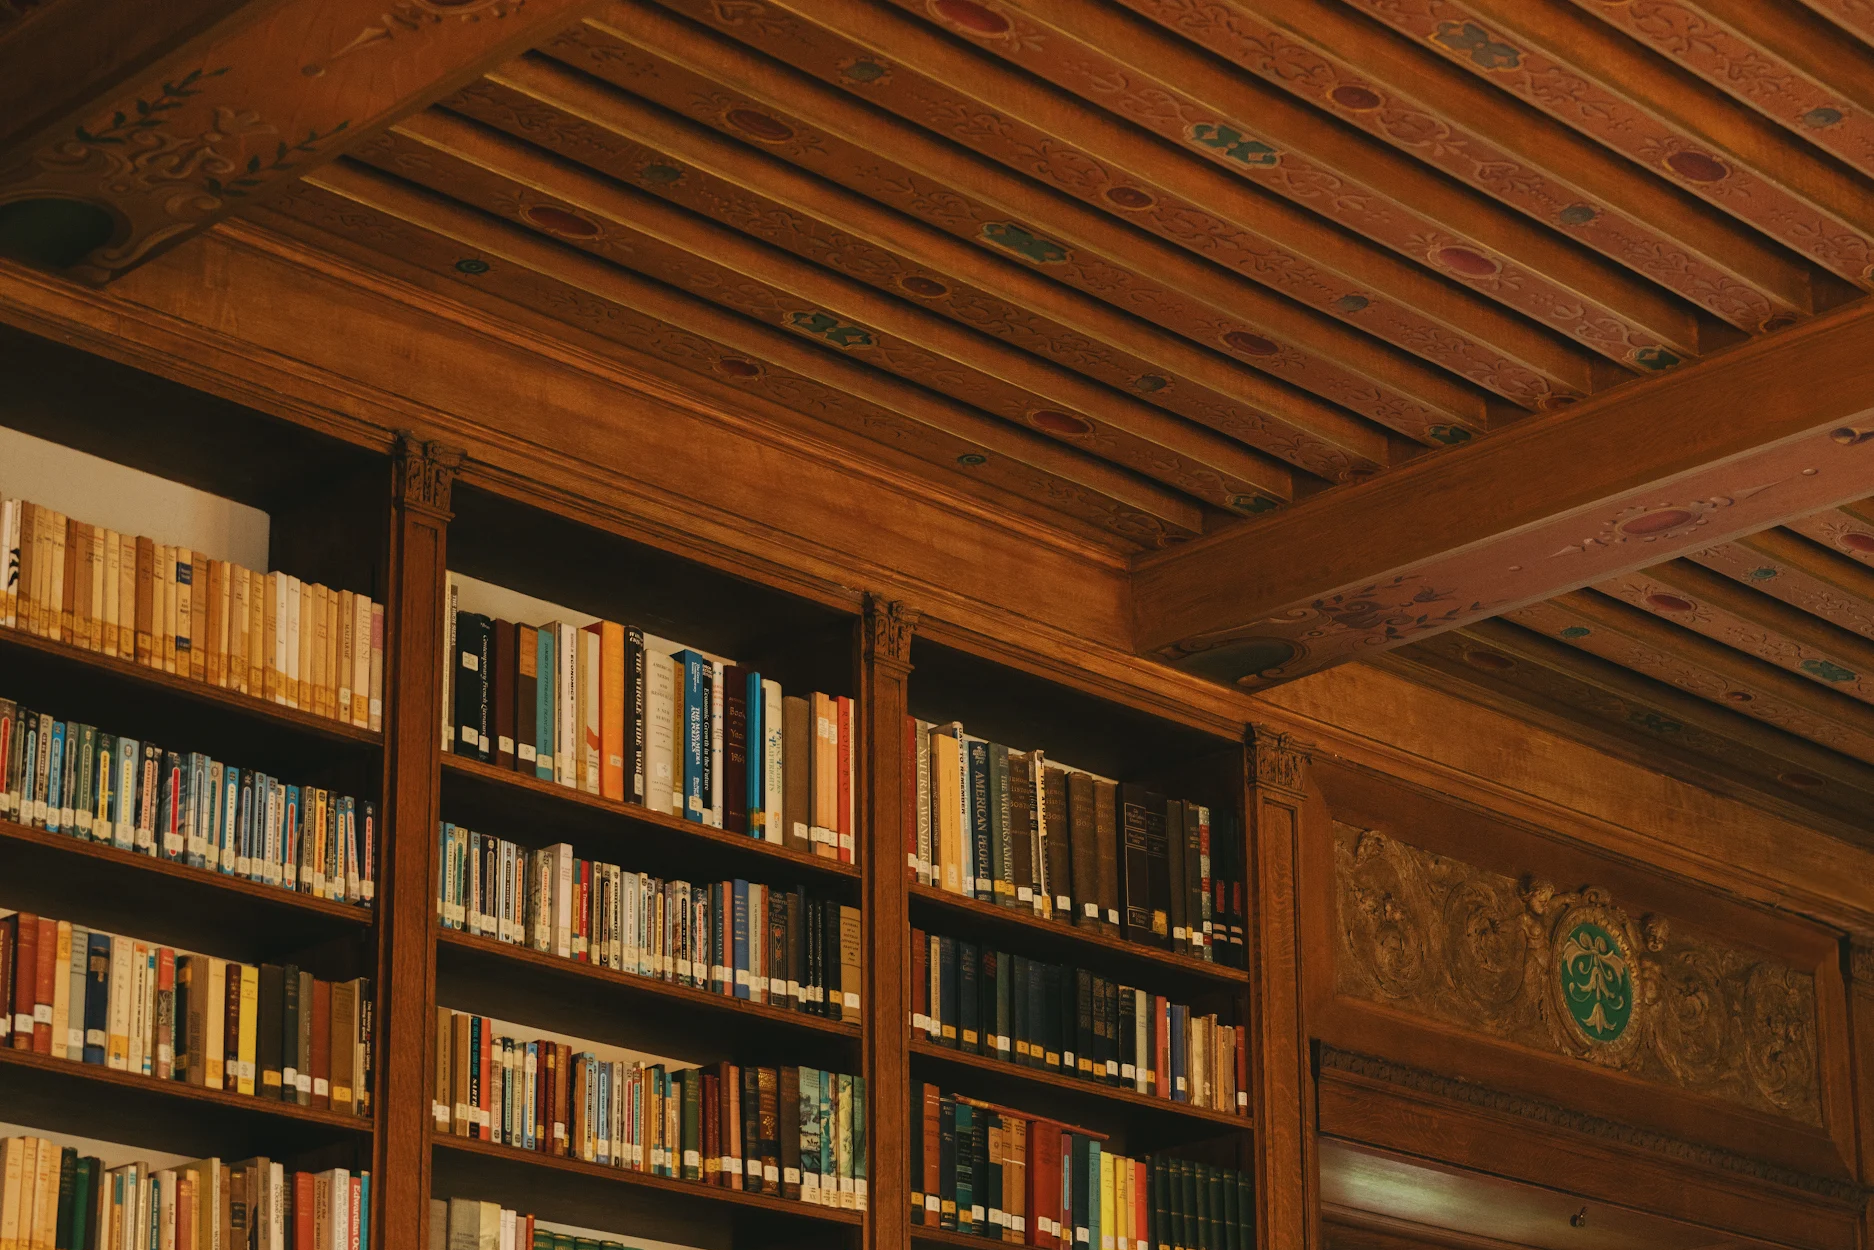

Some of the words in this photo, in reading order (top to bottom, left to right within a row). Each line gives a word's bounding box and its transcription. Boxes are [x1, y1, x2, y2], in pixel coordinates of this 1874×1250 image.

[481, 634, 489, 680] Contemporary
[481, 681, 489, 703] French
[918, 746, 927, 803] NATURAL
[1000, 774, 1009, 792] THE
[975, 771, 987, 832] AMERICAN
[919, 806, 928, 862] WONDER
[978, 835, 987, 879] PEOPLE
[1003, 842, 1014, 884] AMERIC
[352, 1184, 360, 1236] Edwardian
